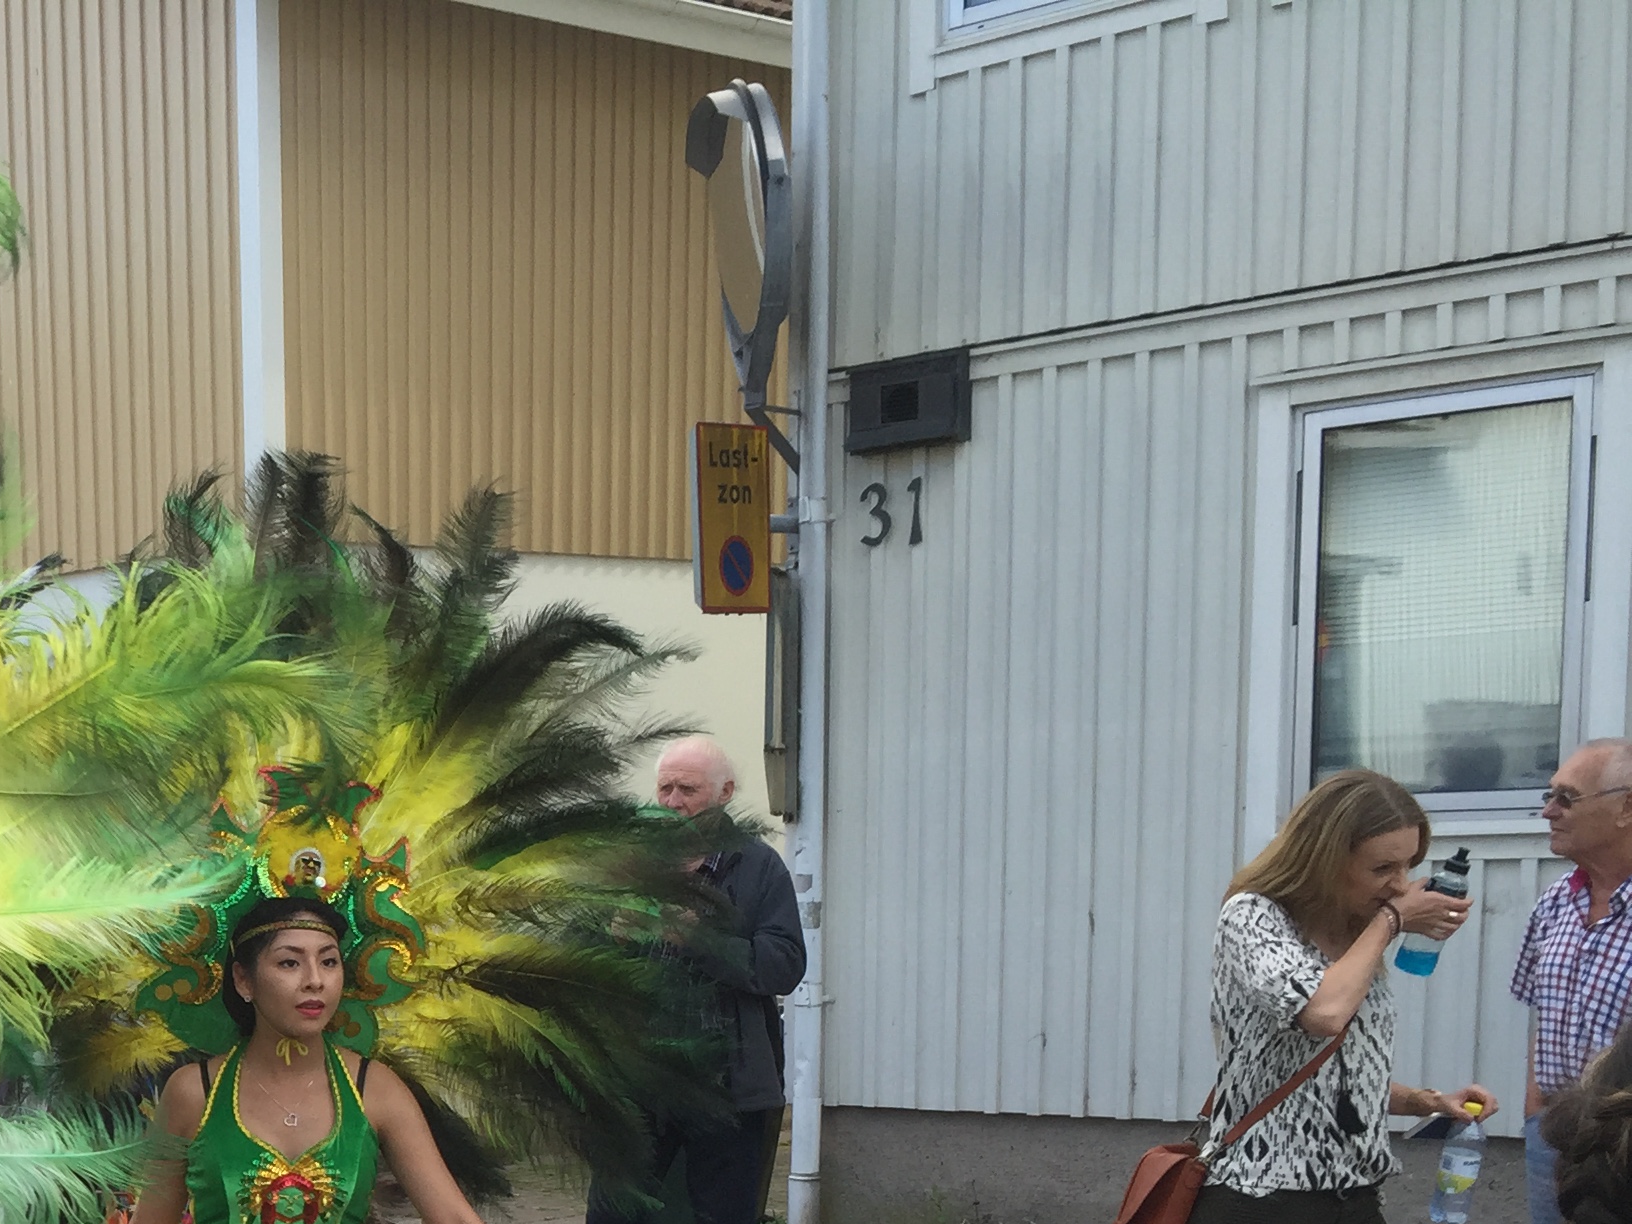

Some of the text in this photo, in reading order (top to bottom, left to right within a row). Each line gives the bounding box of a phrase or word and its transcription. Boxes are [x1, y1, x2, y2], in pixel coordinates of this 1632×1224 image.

[708, 441, 759, 469] Last-
[717, 484, 752, 505] zon
[859, 476, 923, 547] 31
